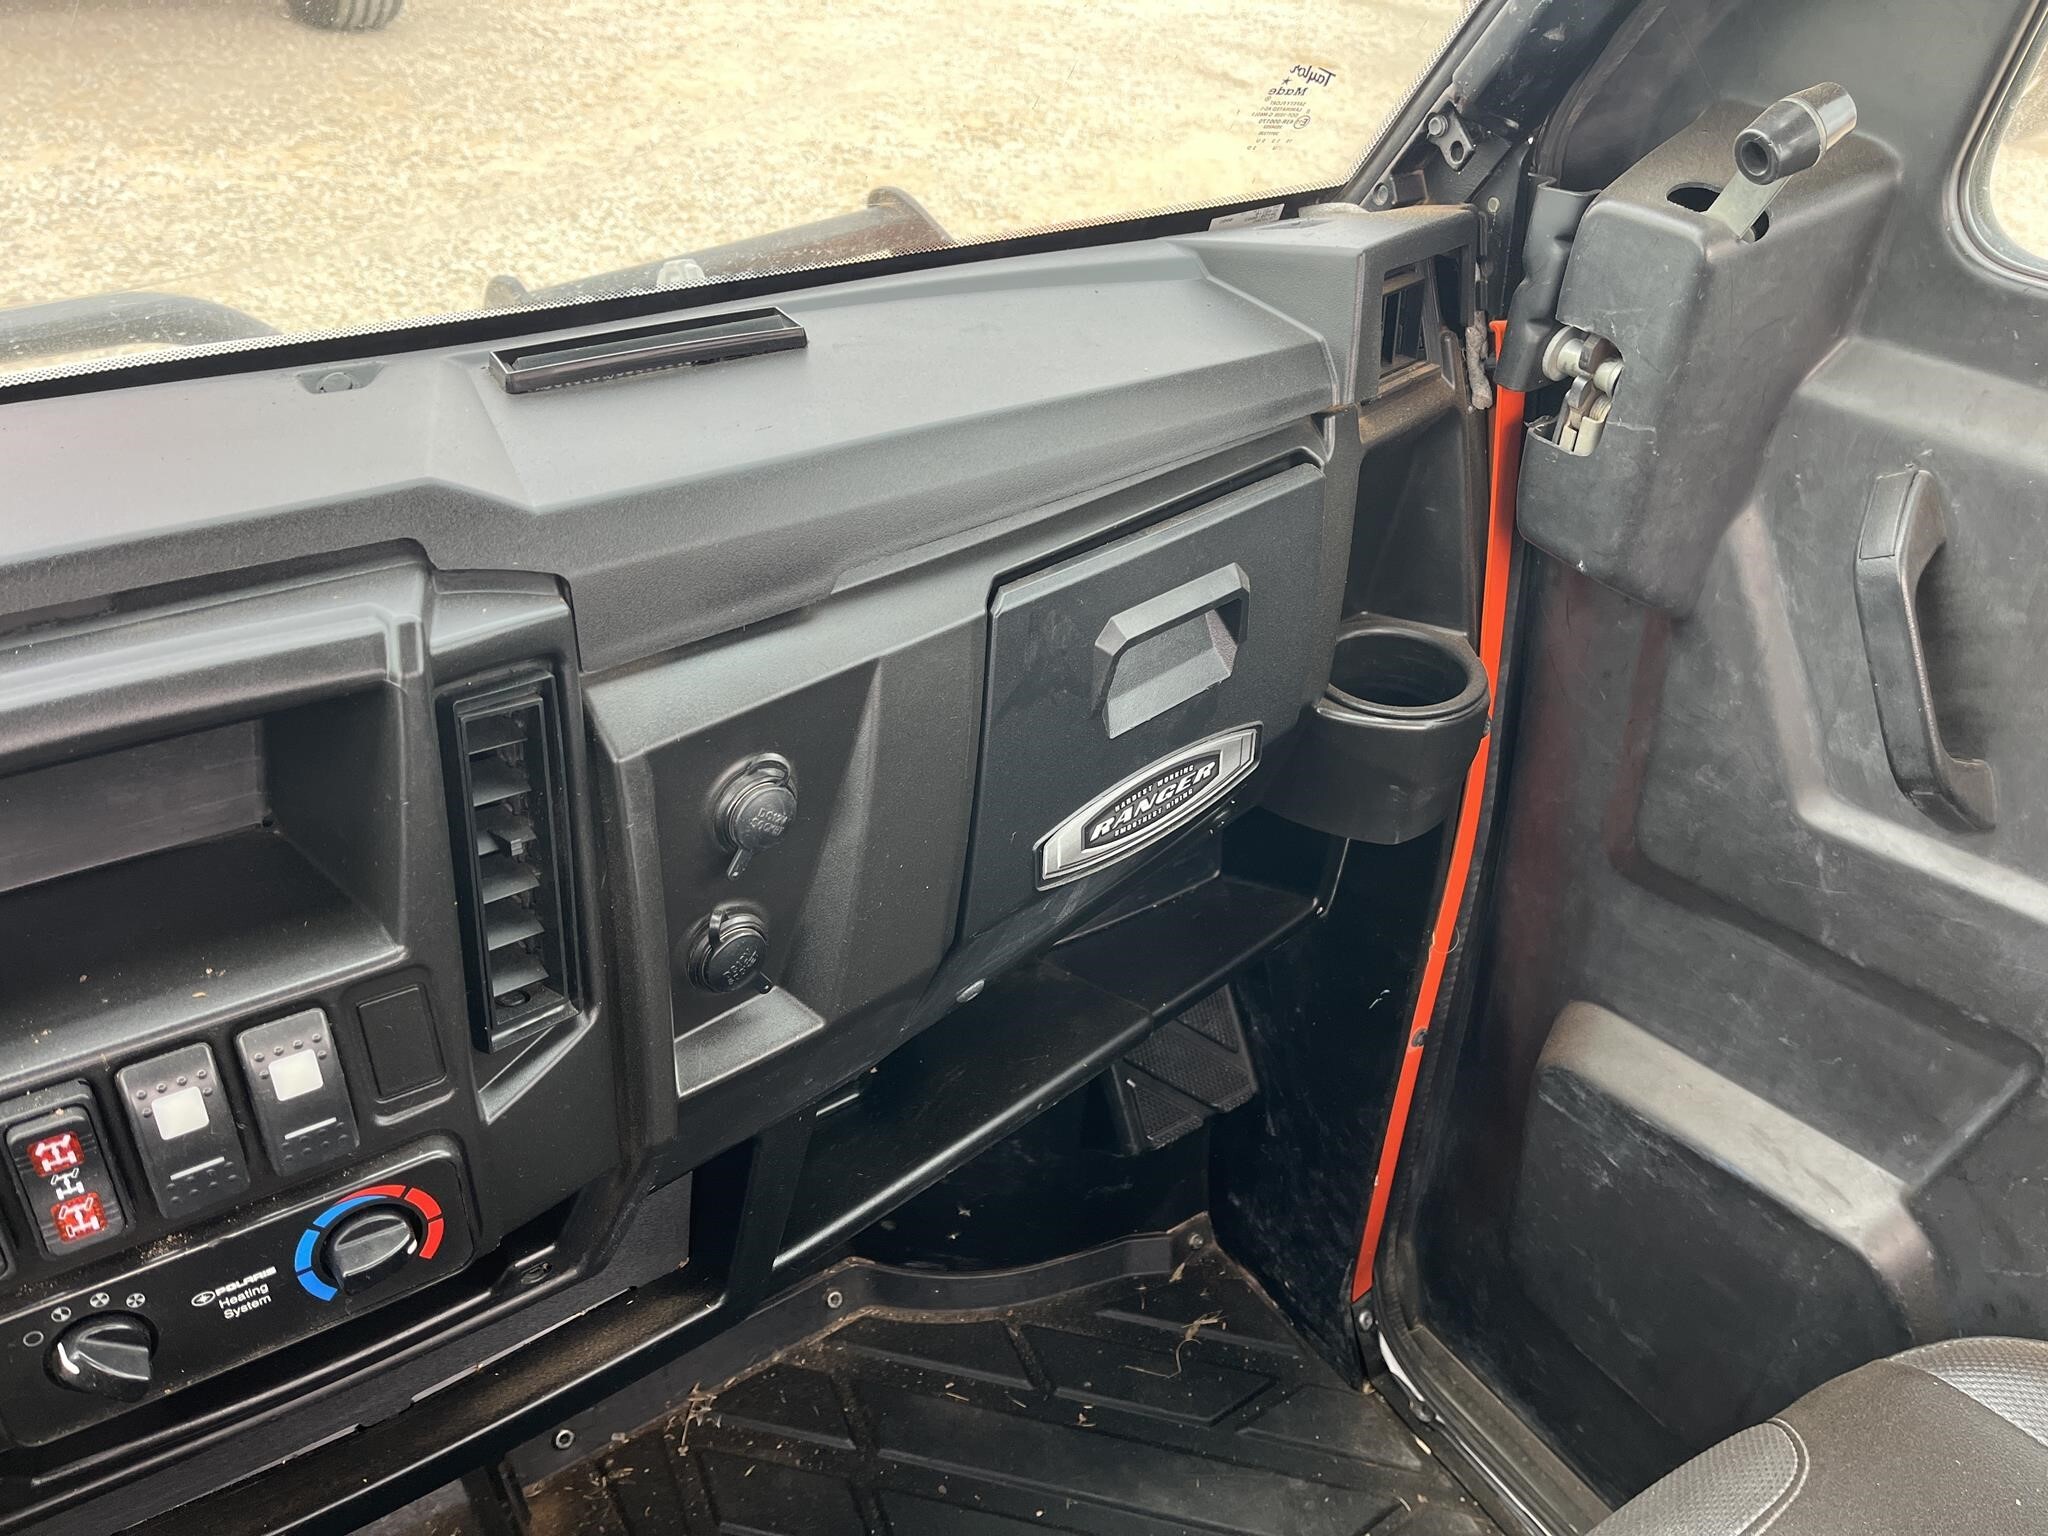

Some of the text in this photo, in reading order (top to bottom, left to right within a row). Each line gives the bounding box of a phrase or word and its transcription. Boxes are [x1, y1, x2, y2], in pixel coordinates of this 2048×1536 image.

[1090, 761, 1216, 842] RANGER
[1114, 765, 1194, 812] HARDEST WORKING
[1114, 788, 1193, 837] SMOOTHEST RIDING
[215, 1265, 277, 1297] POLARIS
[218, 1283, 269, 1309] Heating
[224, 1295, 272, 1319] System
